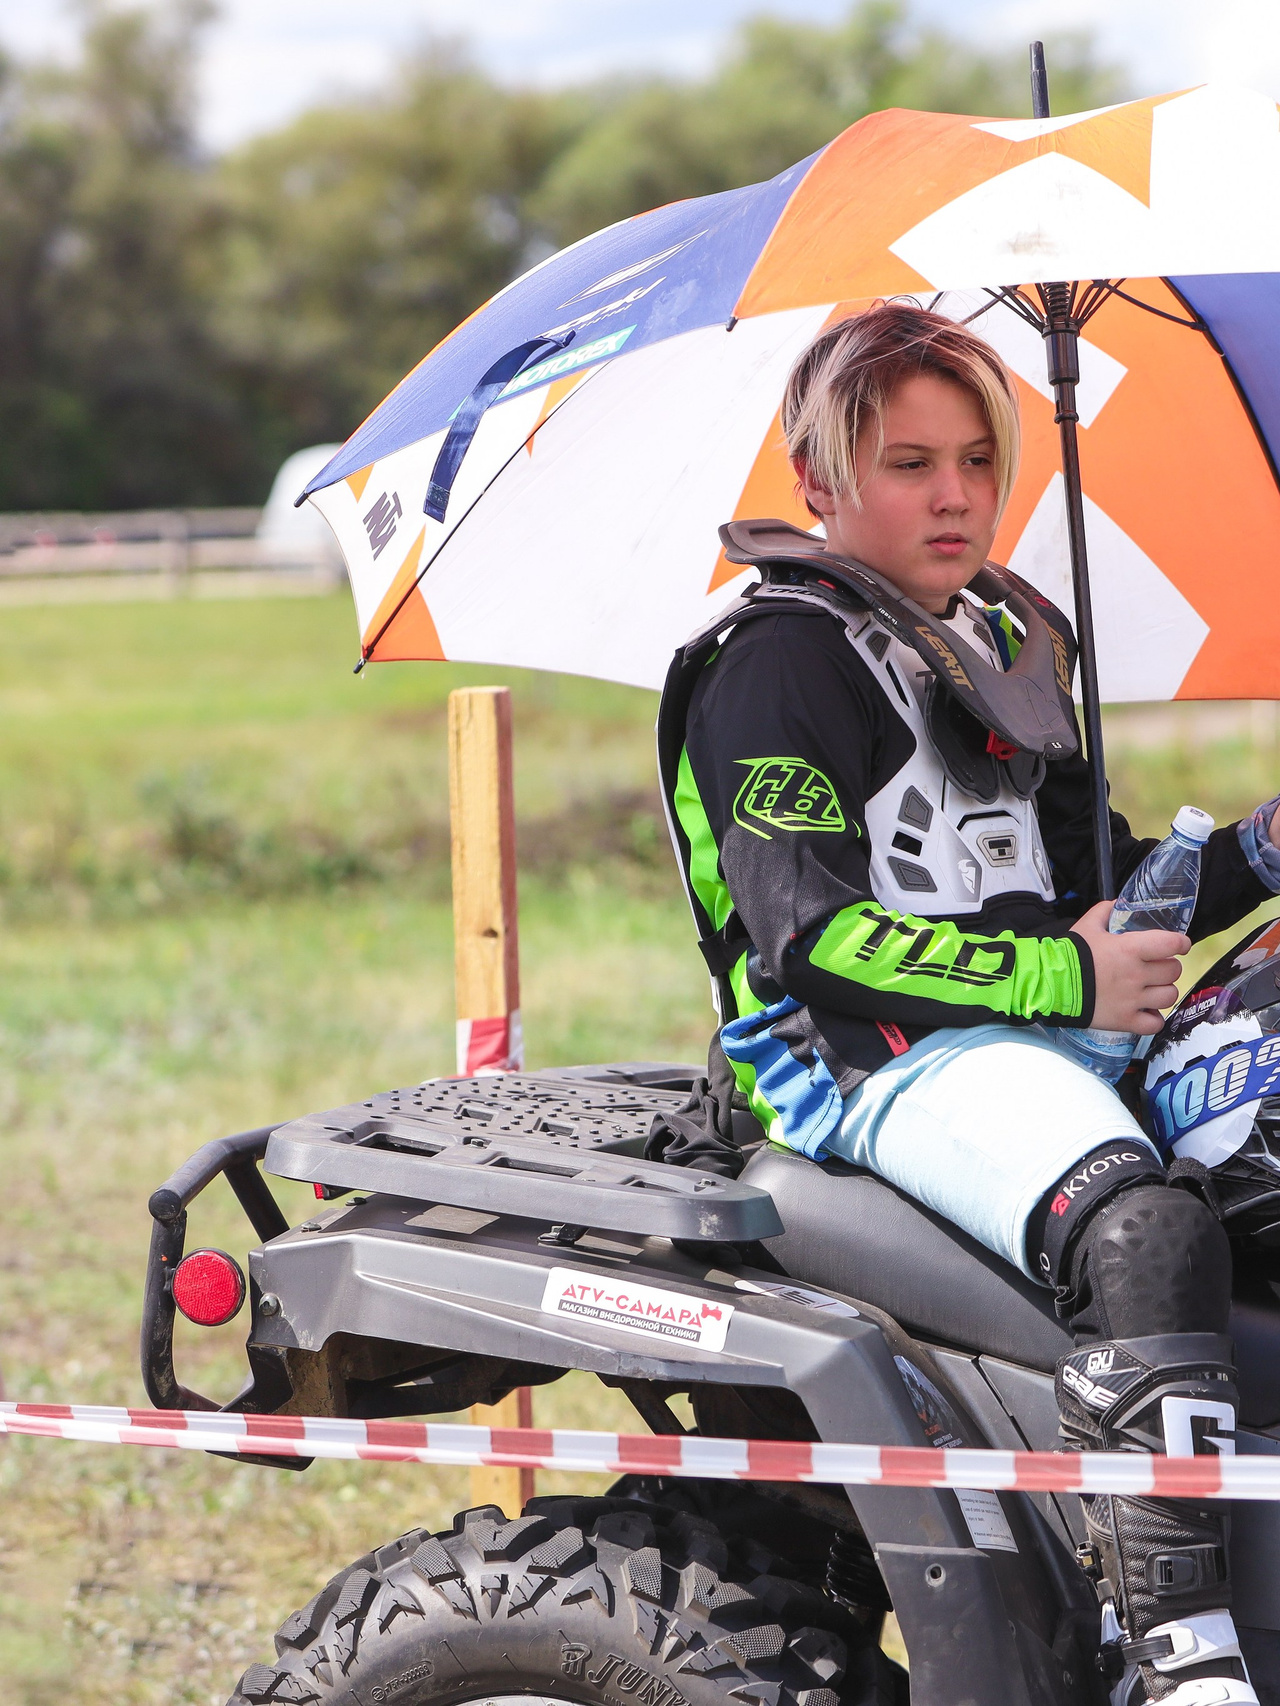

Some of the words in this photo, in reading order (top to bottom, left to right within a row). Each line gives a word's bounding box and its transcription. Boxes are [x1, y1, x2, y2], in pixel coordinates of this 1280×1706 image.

[914, 626, 975, 691] LEATT
[854, 908, 1016, 986] TLD
[1062, 1152, 1141, 1199] KYOTO
[561, 1301, 599, 1318] МАГАЗИН
[599, 1309, 660, 1333] ВНЕДОРОЖНОЙ
[661, 1324, 698, 1341] ТЕХНИКИ
